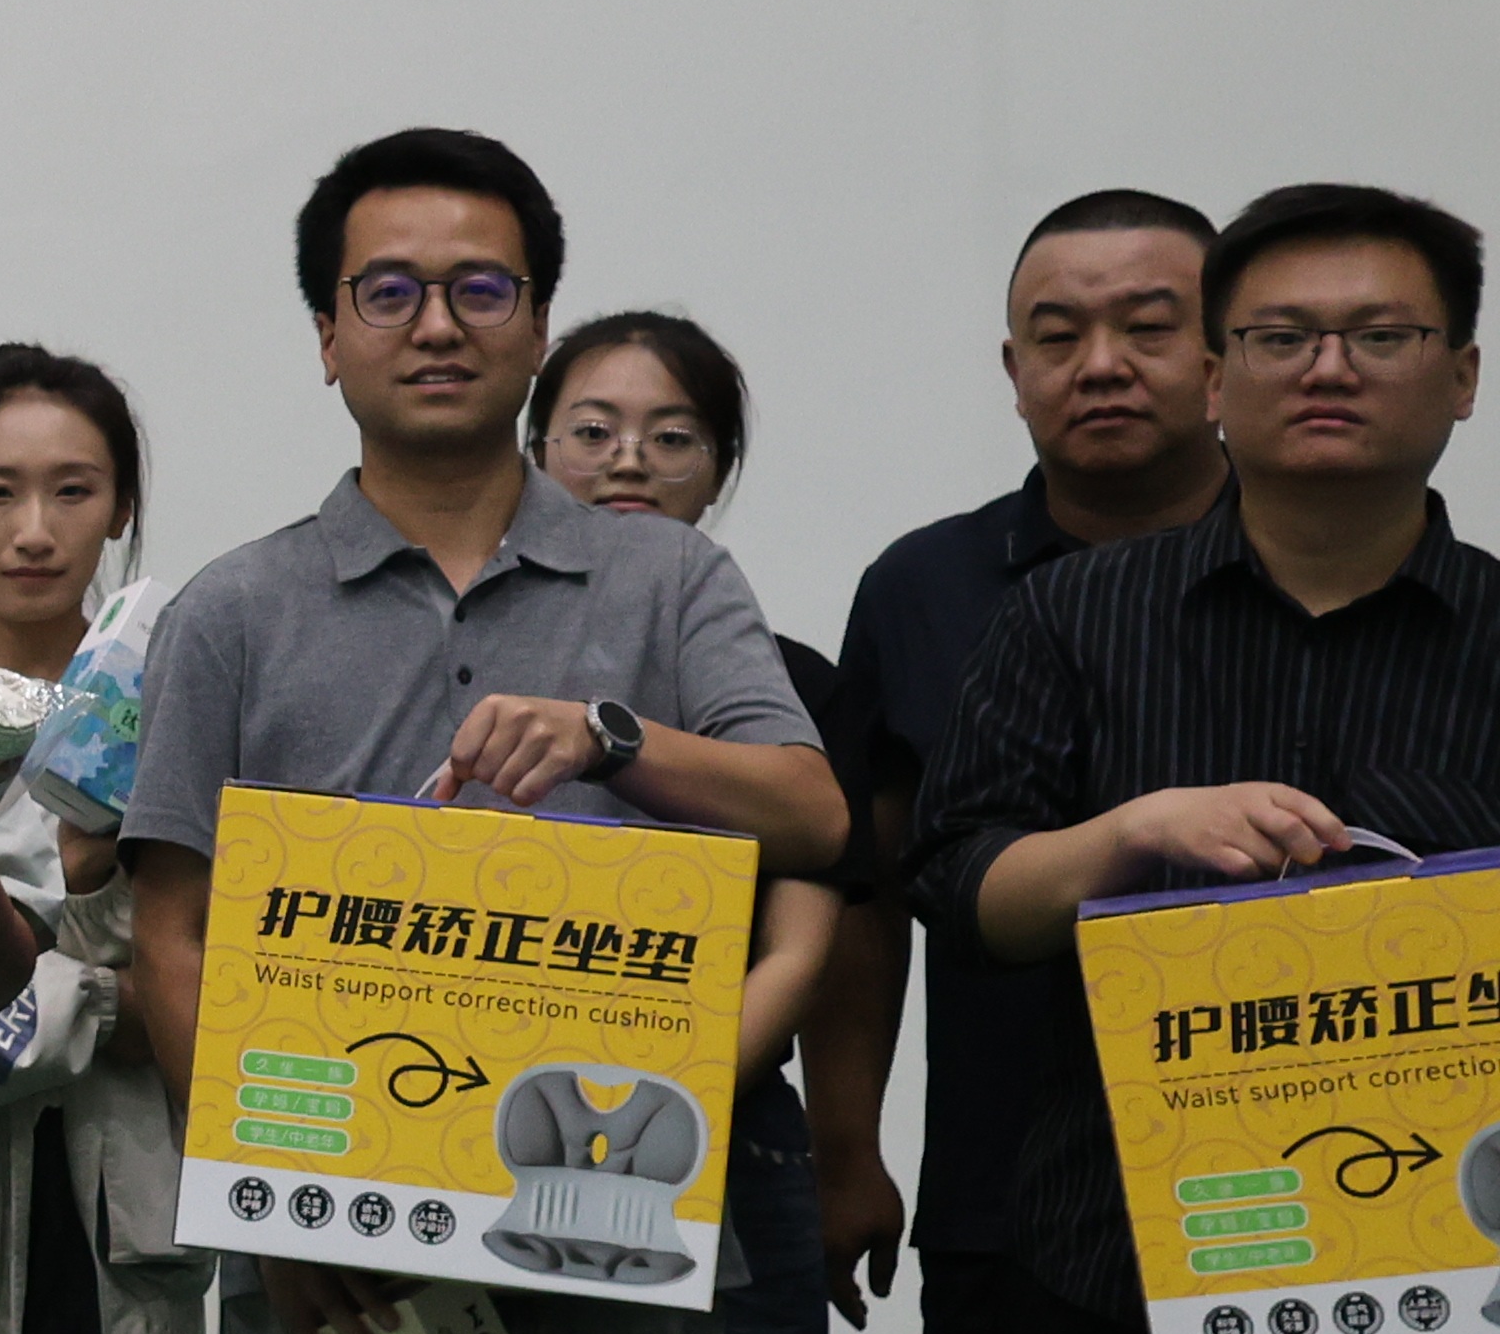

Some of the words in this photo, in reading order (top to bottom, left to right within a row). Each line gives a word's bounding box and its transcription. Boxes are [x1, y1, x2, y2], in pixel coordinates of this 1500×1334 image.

[257, 886, 698, 985] 护腰矫正坐垫
[256, 963, 324, 992] Waist
[333, 972, 433, 1005] support
[443, 987, 578, 1022] correction
[588, 1003, 692, 1034] cushion
[1162, 1084, 1241, 1112] Waist
[1251, 1069, 1359, 1104] support
[1368, 1051, 1500, 1090] correctio
